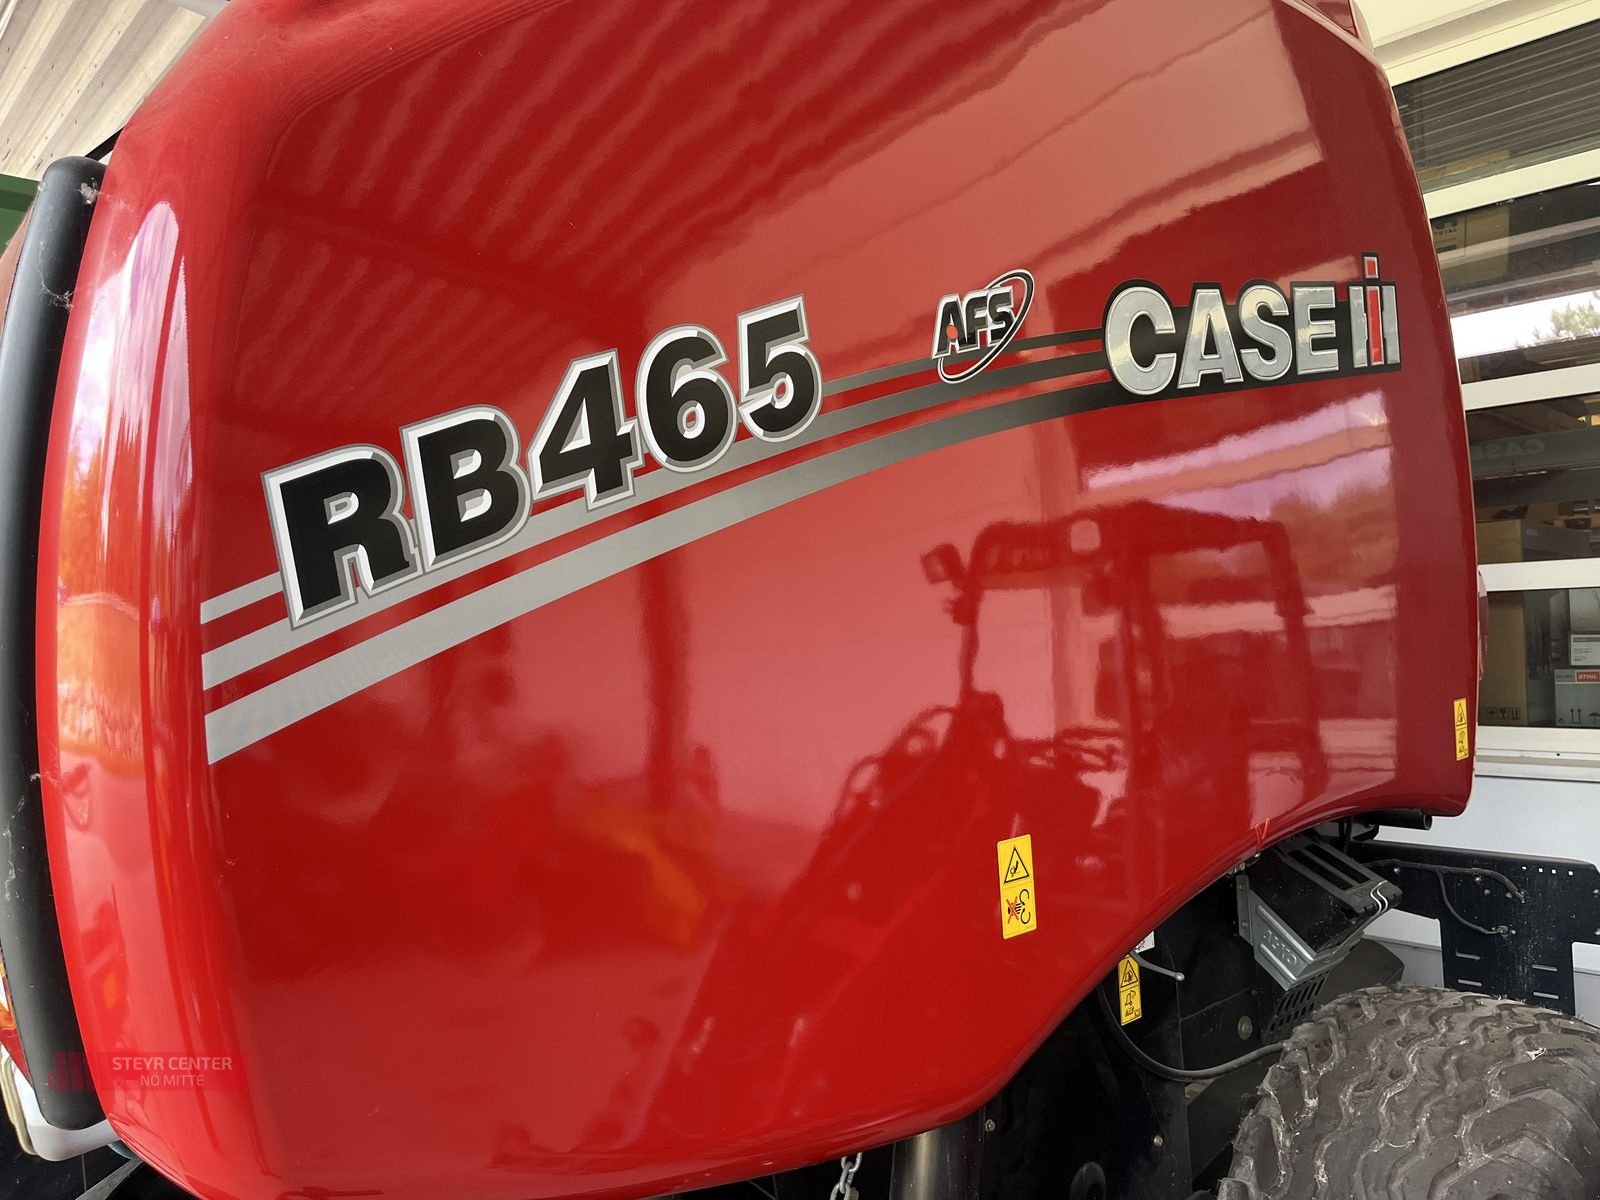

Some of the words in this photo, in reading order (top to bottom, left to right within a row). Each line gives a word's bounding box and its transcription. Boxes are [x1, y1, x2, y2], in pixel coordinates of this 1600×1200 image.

[932, 286, 1015, 358] AFS
[1104, 284, 1340, 396] CASE
[263, 297, 821, 627] RB465
